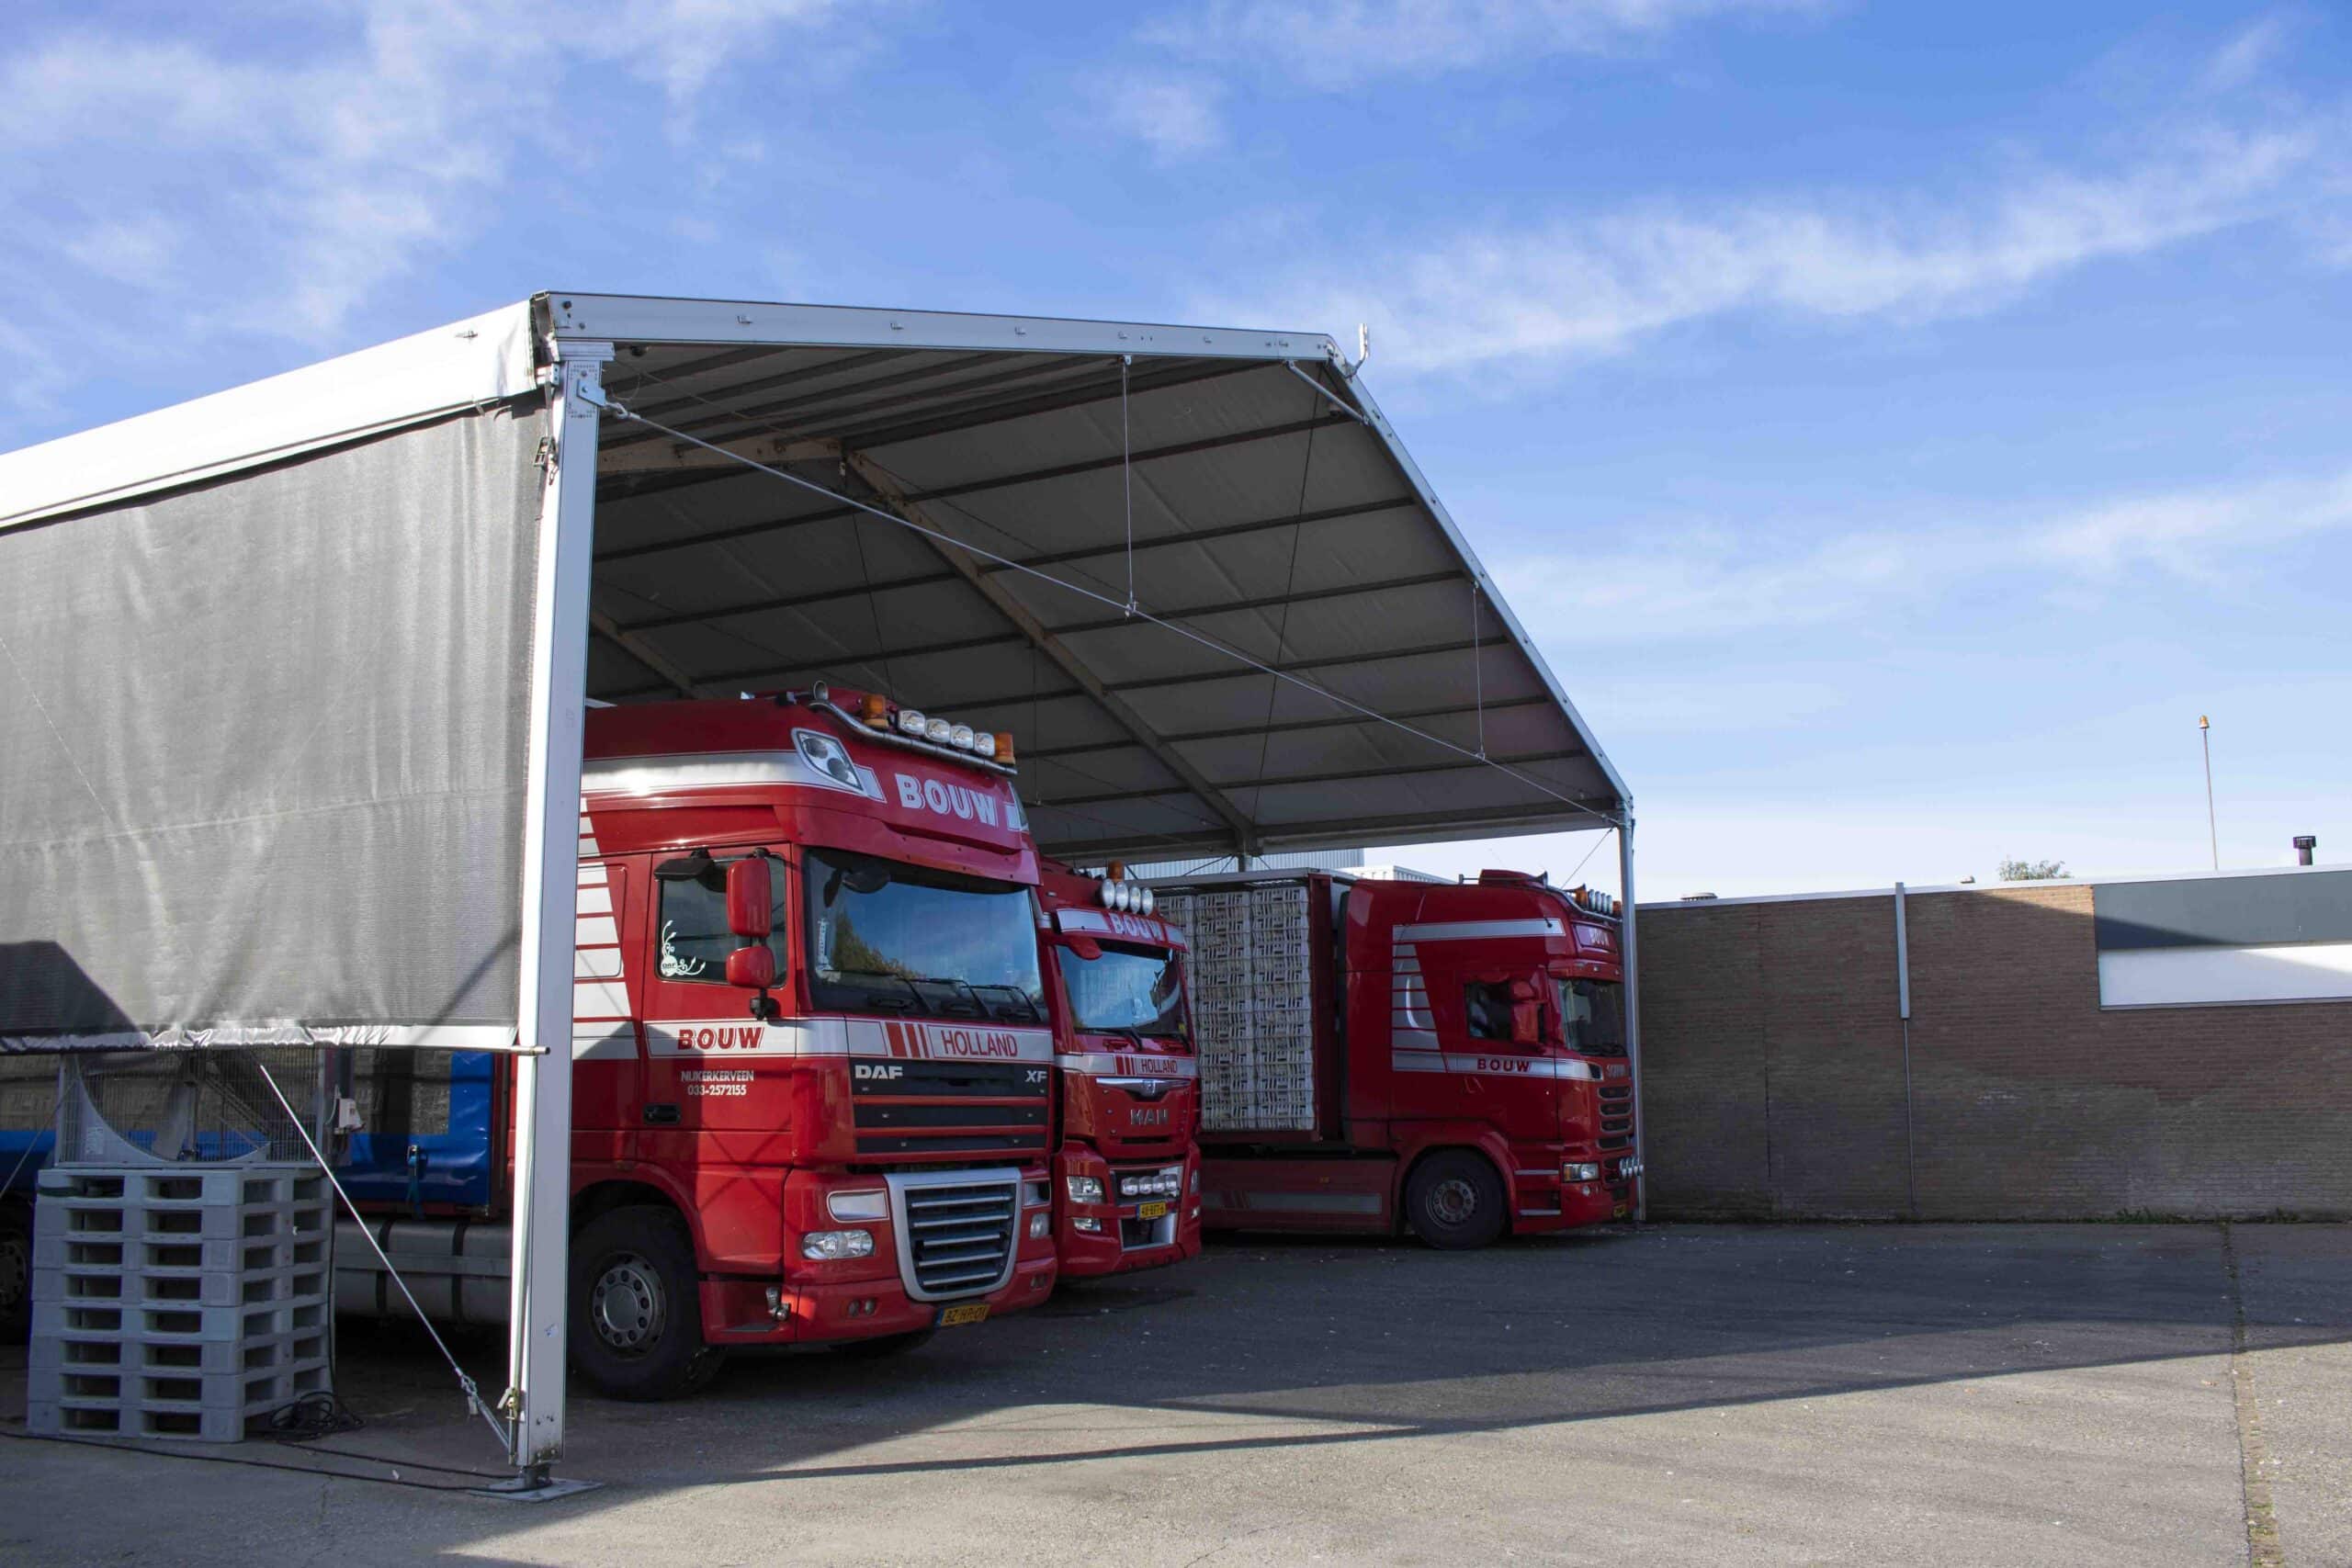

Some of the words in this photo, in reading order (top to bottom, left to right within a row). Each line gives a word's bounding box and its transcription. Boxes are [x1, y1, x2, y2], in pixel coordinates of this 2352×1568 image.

[895, 773, 999, 828] BOUW
[1108, 912, 1165, 941] BOUW
[677, 1027, 764, 1050] BOUW
[941, 1029, 1018, 1057] HOLLAND
[1141, 1058, 1178, 1074] HOLLAND
[1477, 1058, 1530, 1072] BOUW
[681, 1070, 754, 1082] NIJKERKERVEEN
[854, 1065, 903, 1080] DAF
[1025, 1070, 1047, 1083] XF
[687, 1085, 747, 1096] 033-2572155
[1130, 1109, 1169, 1125] MAN
